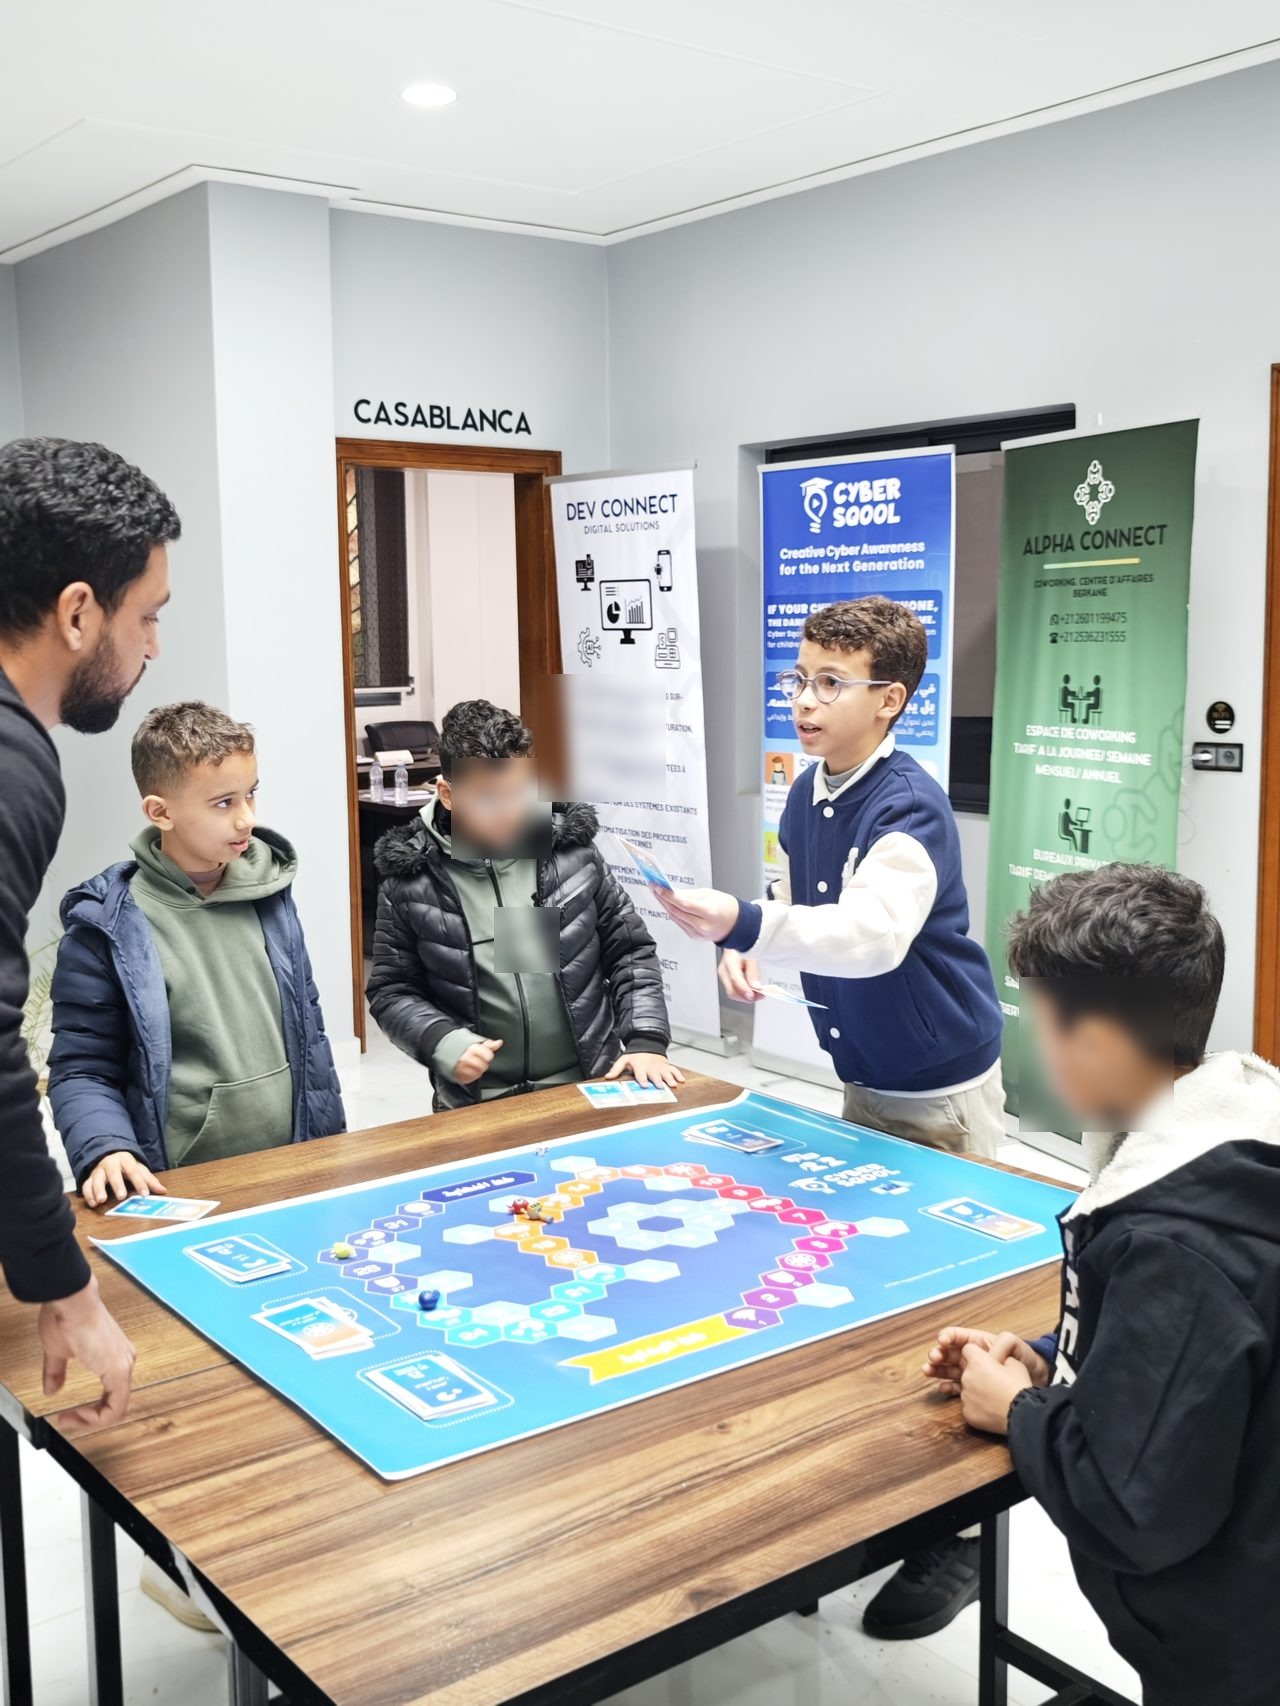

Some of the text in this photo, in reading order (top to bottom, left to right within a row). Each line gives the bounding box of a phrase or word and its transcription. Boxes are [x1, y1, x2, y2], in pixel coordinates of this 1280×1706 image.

[354, 399, 532, 435] CASABLANCA
[832, 477, 901, 504] CYBER
[566, 494, 678, 521] DEV CONNECT
[832, 502, 901, 528] SQOOL
[584, 521, 660, 535] DIGITAL SOLUTIONS
[1022, 524, 1168, 556] ALPHA CONNECT
[780, 542, 925, 560] Creative Cyber Awareness
[780, 557, 925, 575] for the Next Generation
[767, 604, 777, 615] IF
[778, 603, 809, 614] YOUR
[767, 618, 782, 627] THE
[1026, 724, 1136, 744] ESPACE DE COWORKING
[1013, 742, 1037, 754] TARIF
[1046, 745, 1056, 757] LA
[1106, 750, 1152, 766] SEMAINE
[1081, 768, 1122, 784] ANNUEL
[1033, 848, 1074, 867] BUREAUX
[1008, 863, 1033, 878] TARIF
